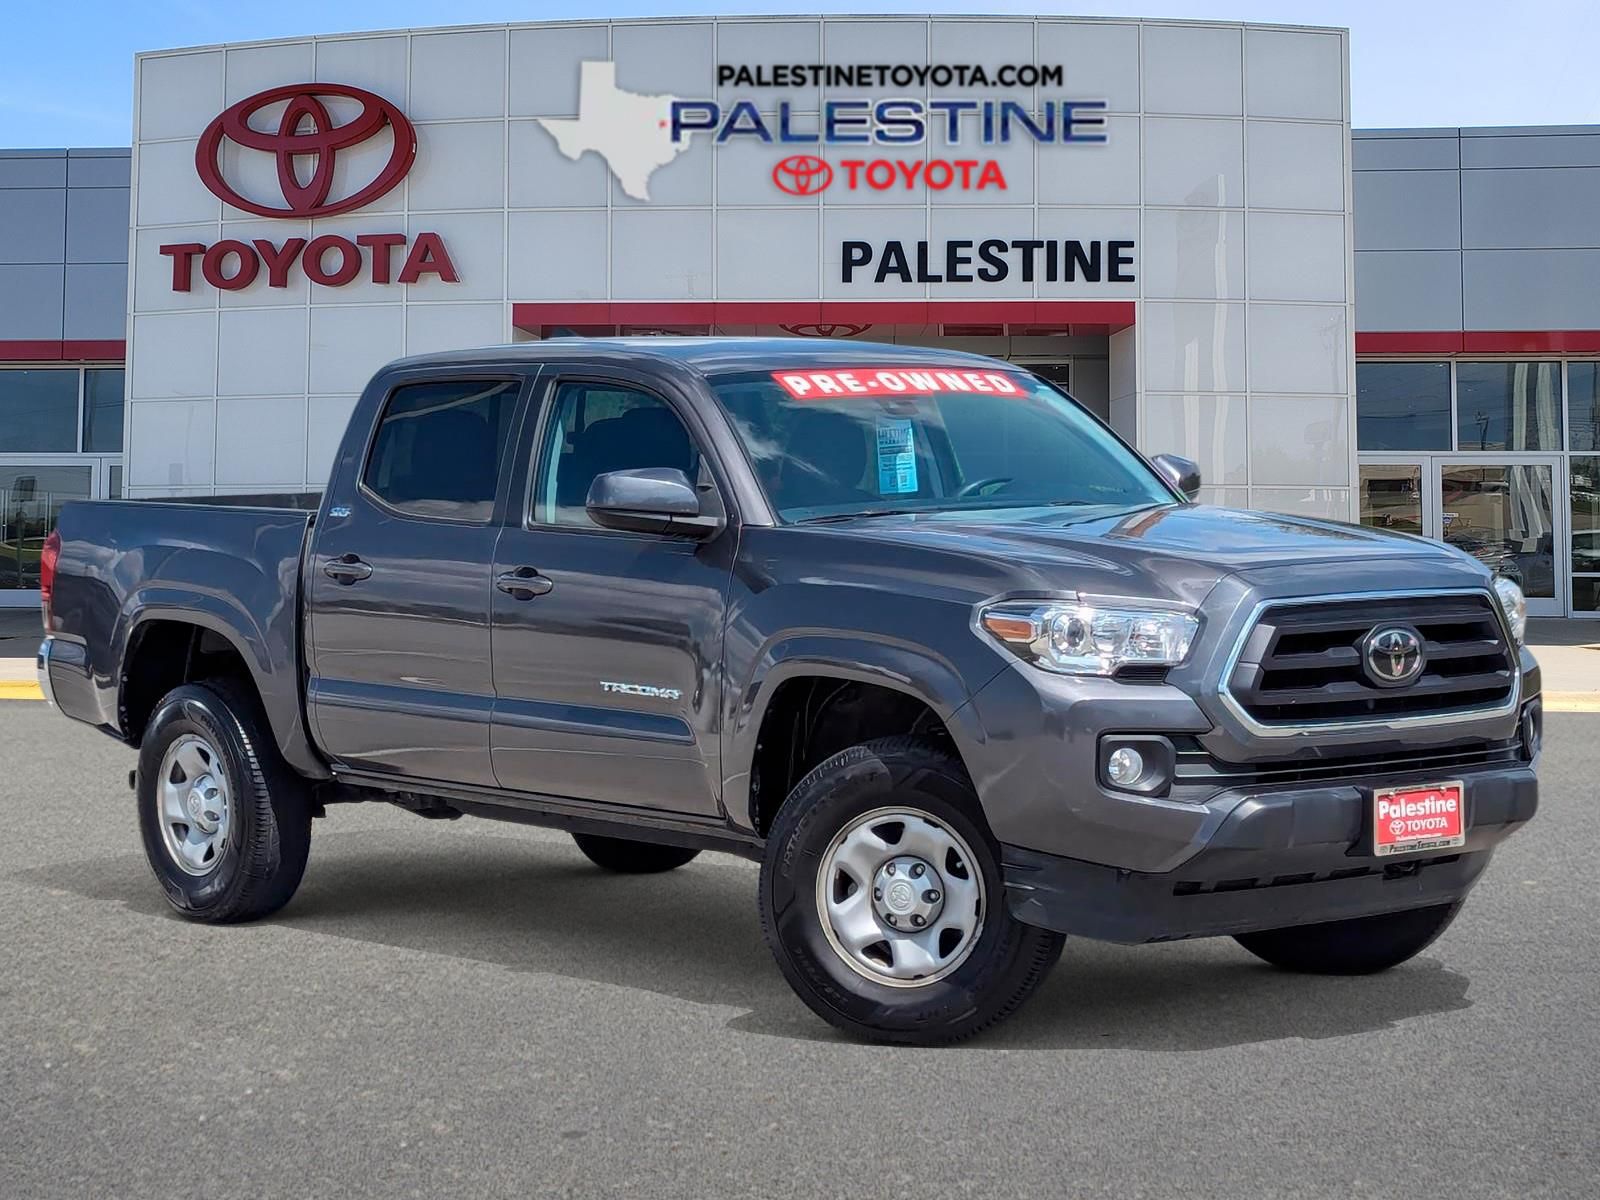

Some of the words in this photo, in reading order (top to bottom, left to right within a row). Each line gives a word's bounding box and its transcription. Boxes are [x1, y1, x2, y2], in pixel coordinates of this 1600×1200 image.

[159, 232, 461, 293] TOYOTA
[841, 240, 1136, 283] PALESTINE
[782, 371, 1017, 396] PRE-OWNED
[600, 681, 682, 699] TACOMA
[1378, 796, 1456, 819] Palestine
[1407, 817, 1448, 832] TOYOTA
